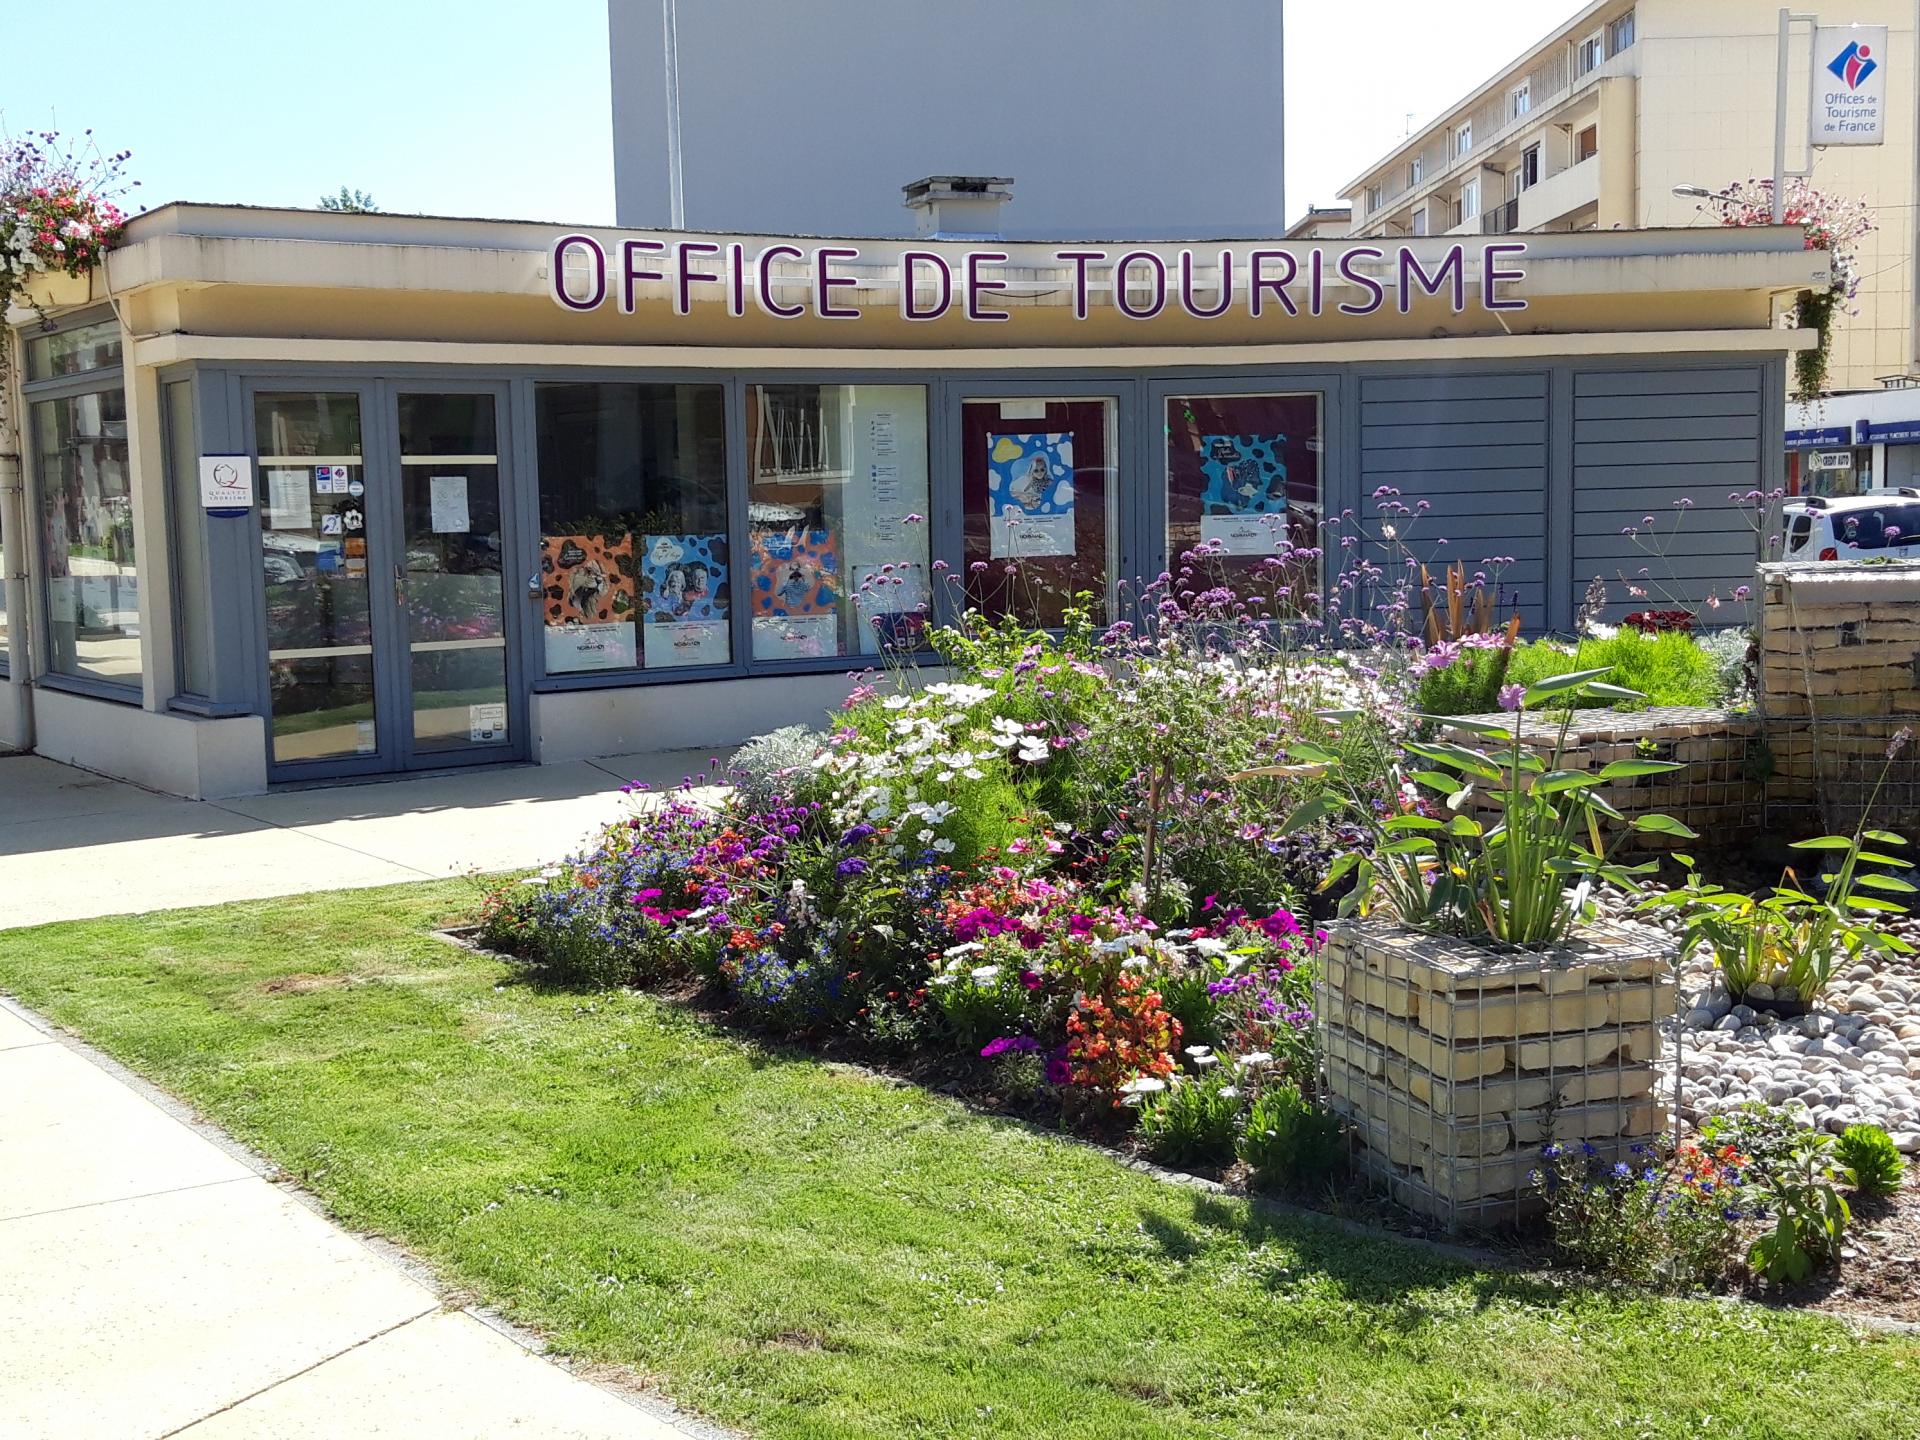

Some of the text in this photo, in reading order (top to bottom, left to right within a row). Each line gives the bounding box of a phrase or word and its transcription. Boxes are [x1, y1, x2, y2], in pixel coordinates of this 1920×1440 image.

[1825, 93, 1878, 104] Offices de
[1825, 106, 1877, 118] Tourisme
[1824, 120, 1876, 132] de France
[550, 232, 1529, 323] OFFICE DE TOURISME
